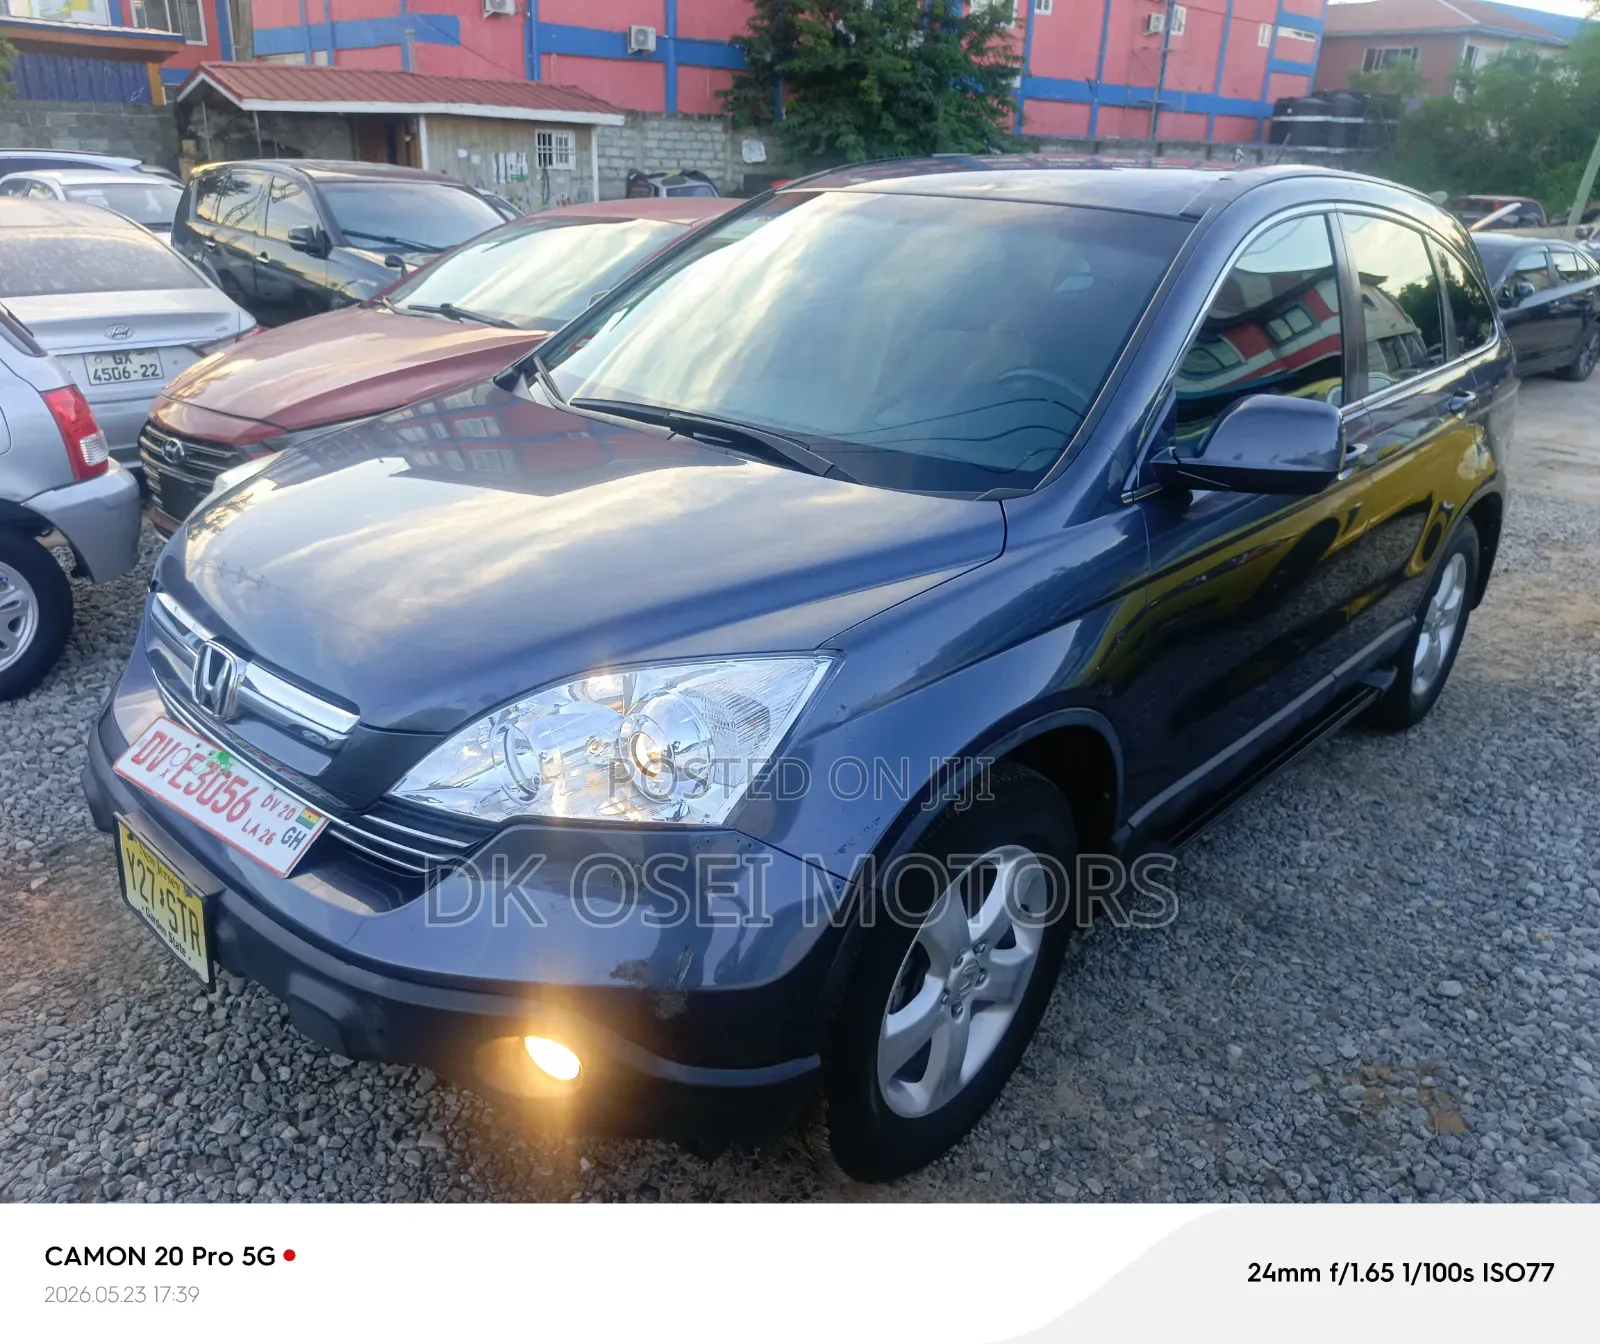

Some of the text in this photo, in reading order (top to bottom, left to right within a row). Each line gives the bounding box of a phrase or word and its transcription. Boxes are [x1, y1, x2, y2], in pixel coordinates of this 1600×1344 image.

[93, 363, 160, 382] 4506-22
[260, 792, 297, 821] DV 20
[241, 816, 277, 847] LA 26
[280, 826, 307, 851] GH
[138, 842, 181, 893] New Jersey
[145, 905, 187, 957] Garden State
